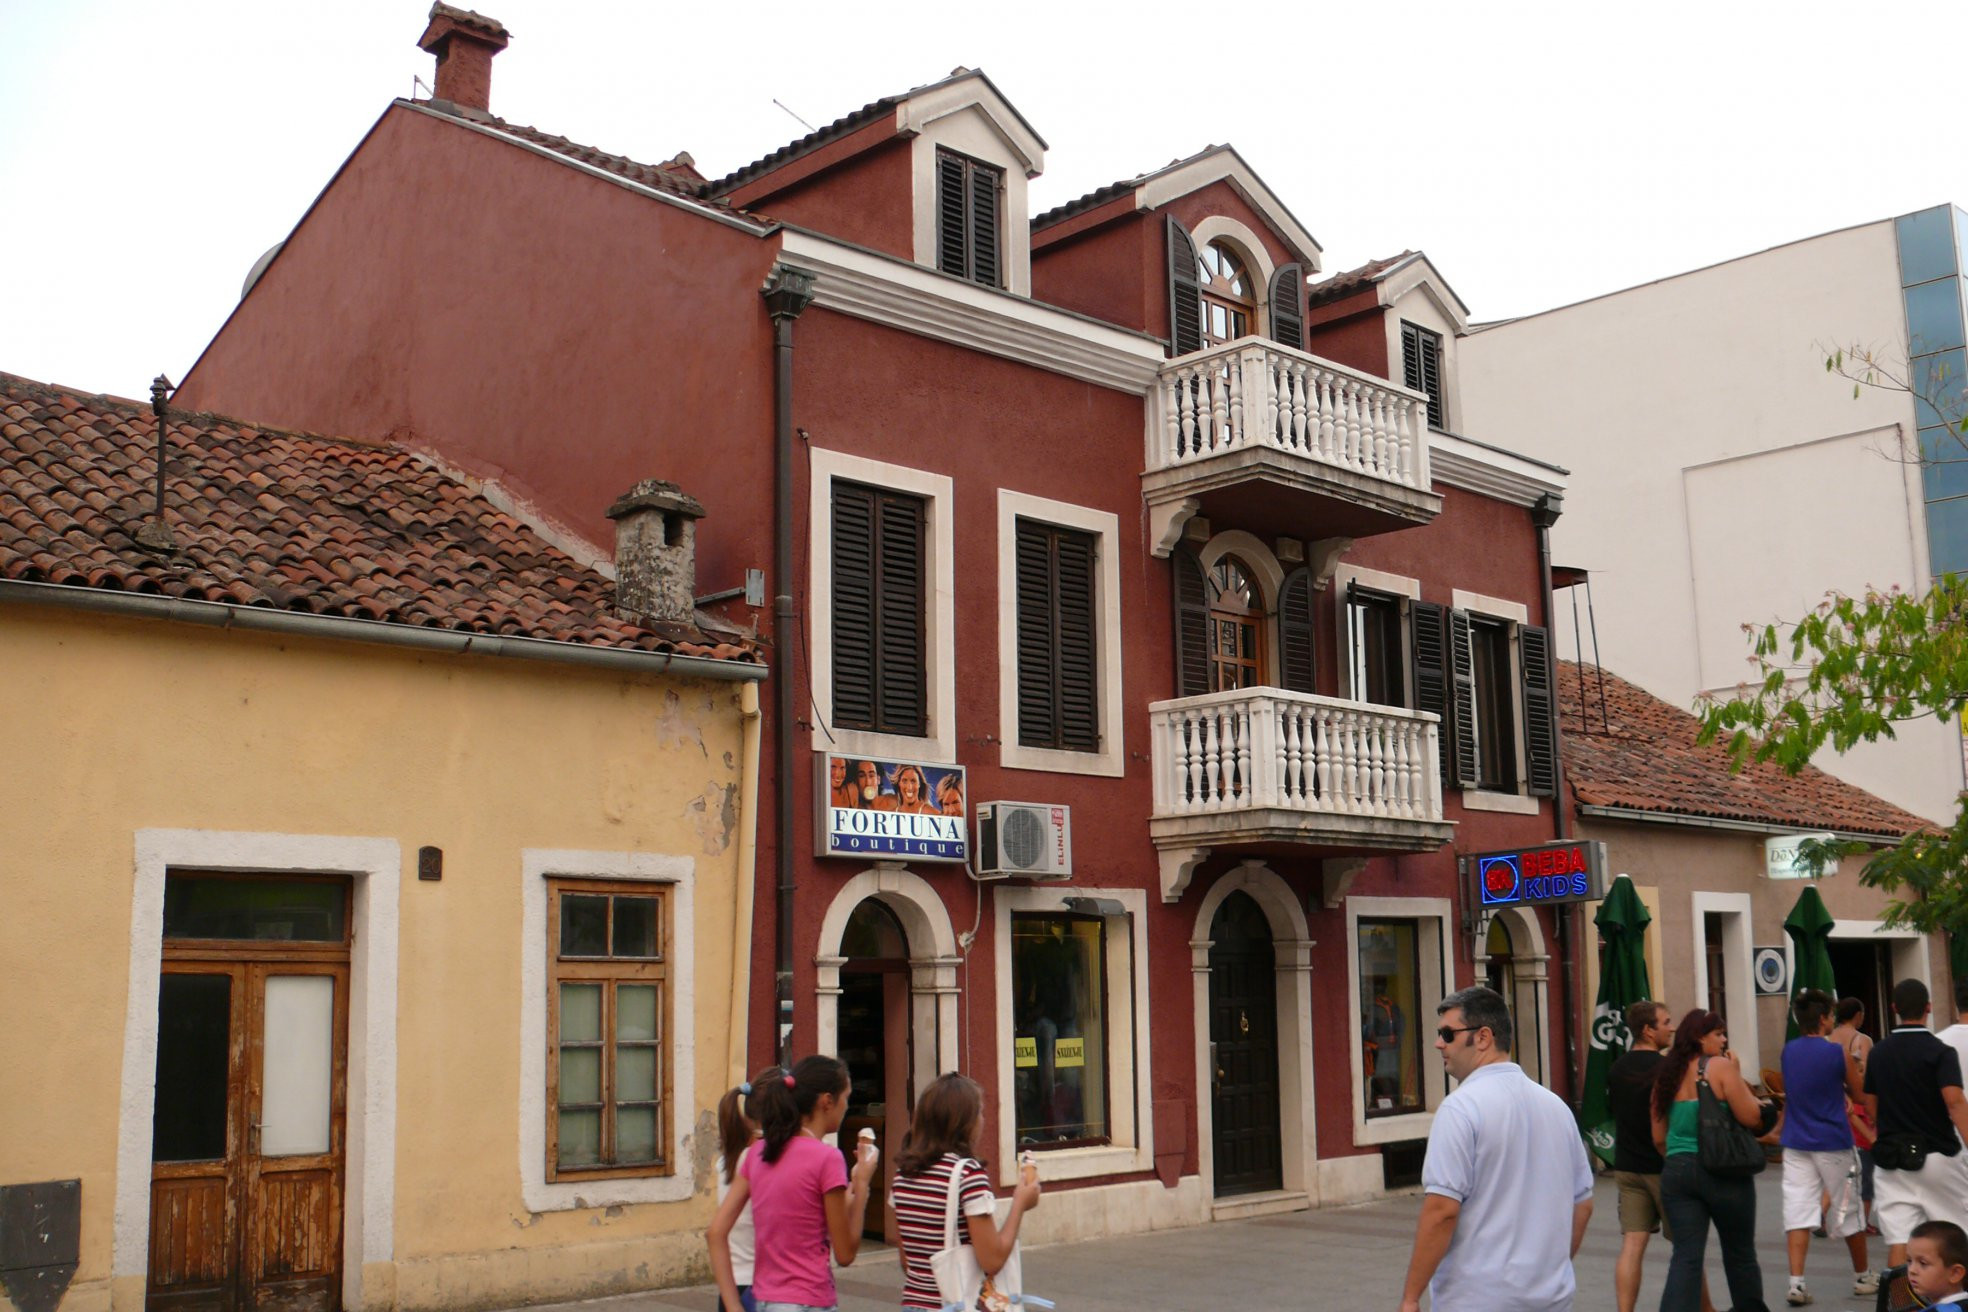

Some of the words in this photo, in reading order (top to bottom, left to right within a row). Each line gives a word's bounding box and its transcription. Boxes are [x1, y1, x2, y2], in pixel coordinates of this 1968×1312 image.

[833, 809, 960, 840] FORTUNA
[831, 834, 964, 854] boutique
[1521, 847, 1587, 877] BEBA
[1486, 867, 1513, 891] BK
[1524, 872, 1588, 899] KIDS
